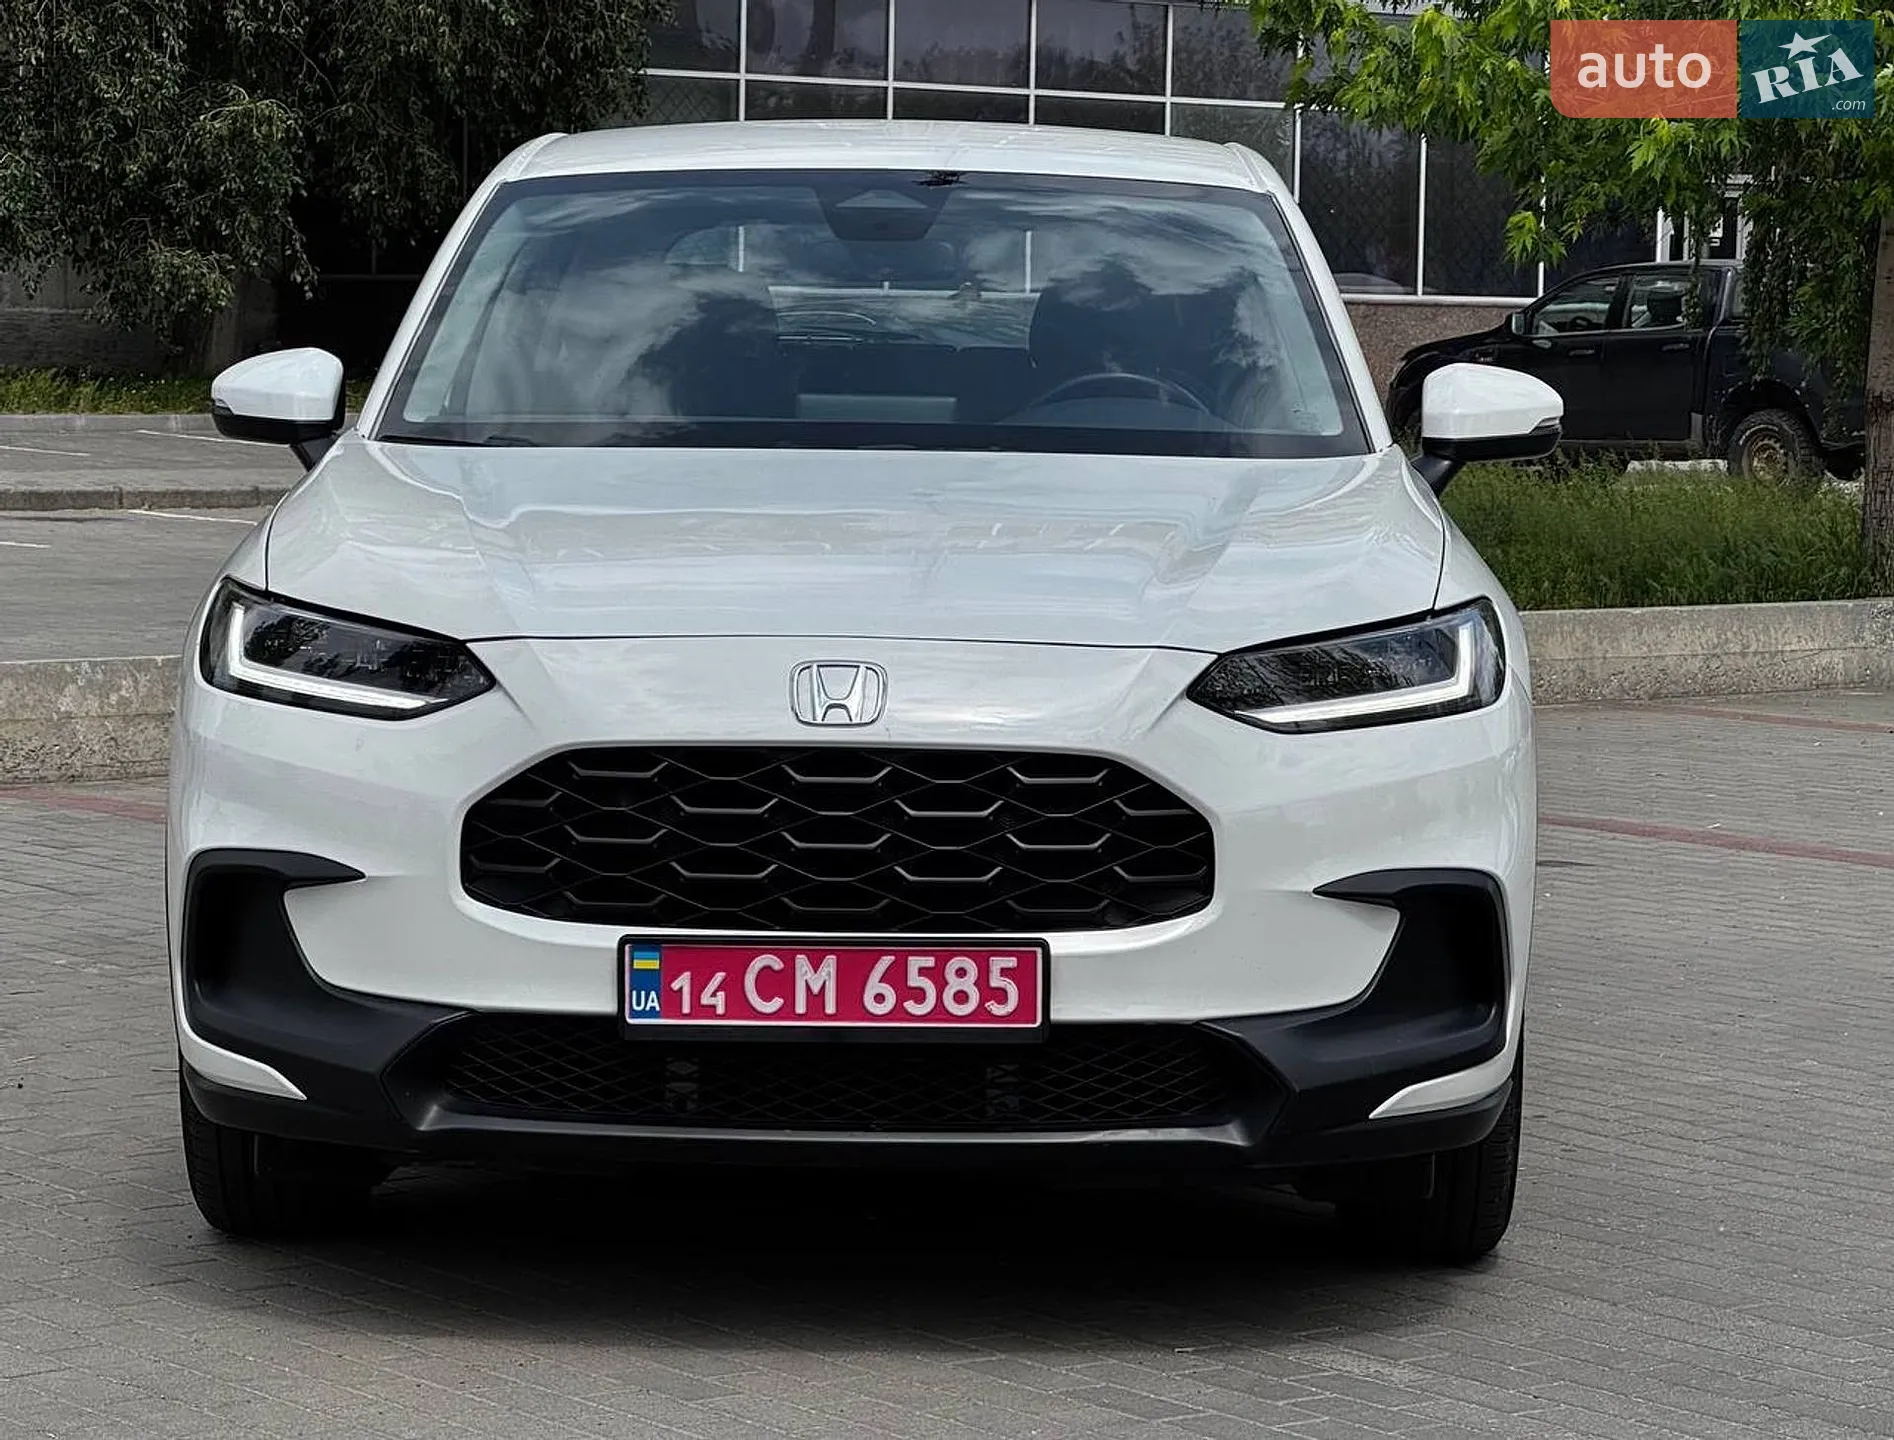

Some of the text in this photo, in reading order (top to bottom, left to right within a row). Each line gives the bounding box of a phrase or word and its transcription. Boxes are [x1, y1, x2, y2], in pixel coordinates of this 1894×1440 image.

[632, 989, 660, 1011] UA
[670, 954, 1019, 1017] 14 CM 6585
